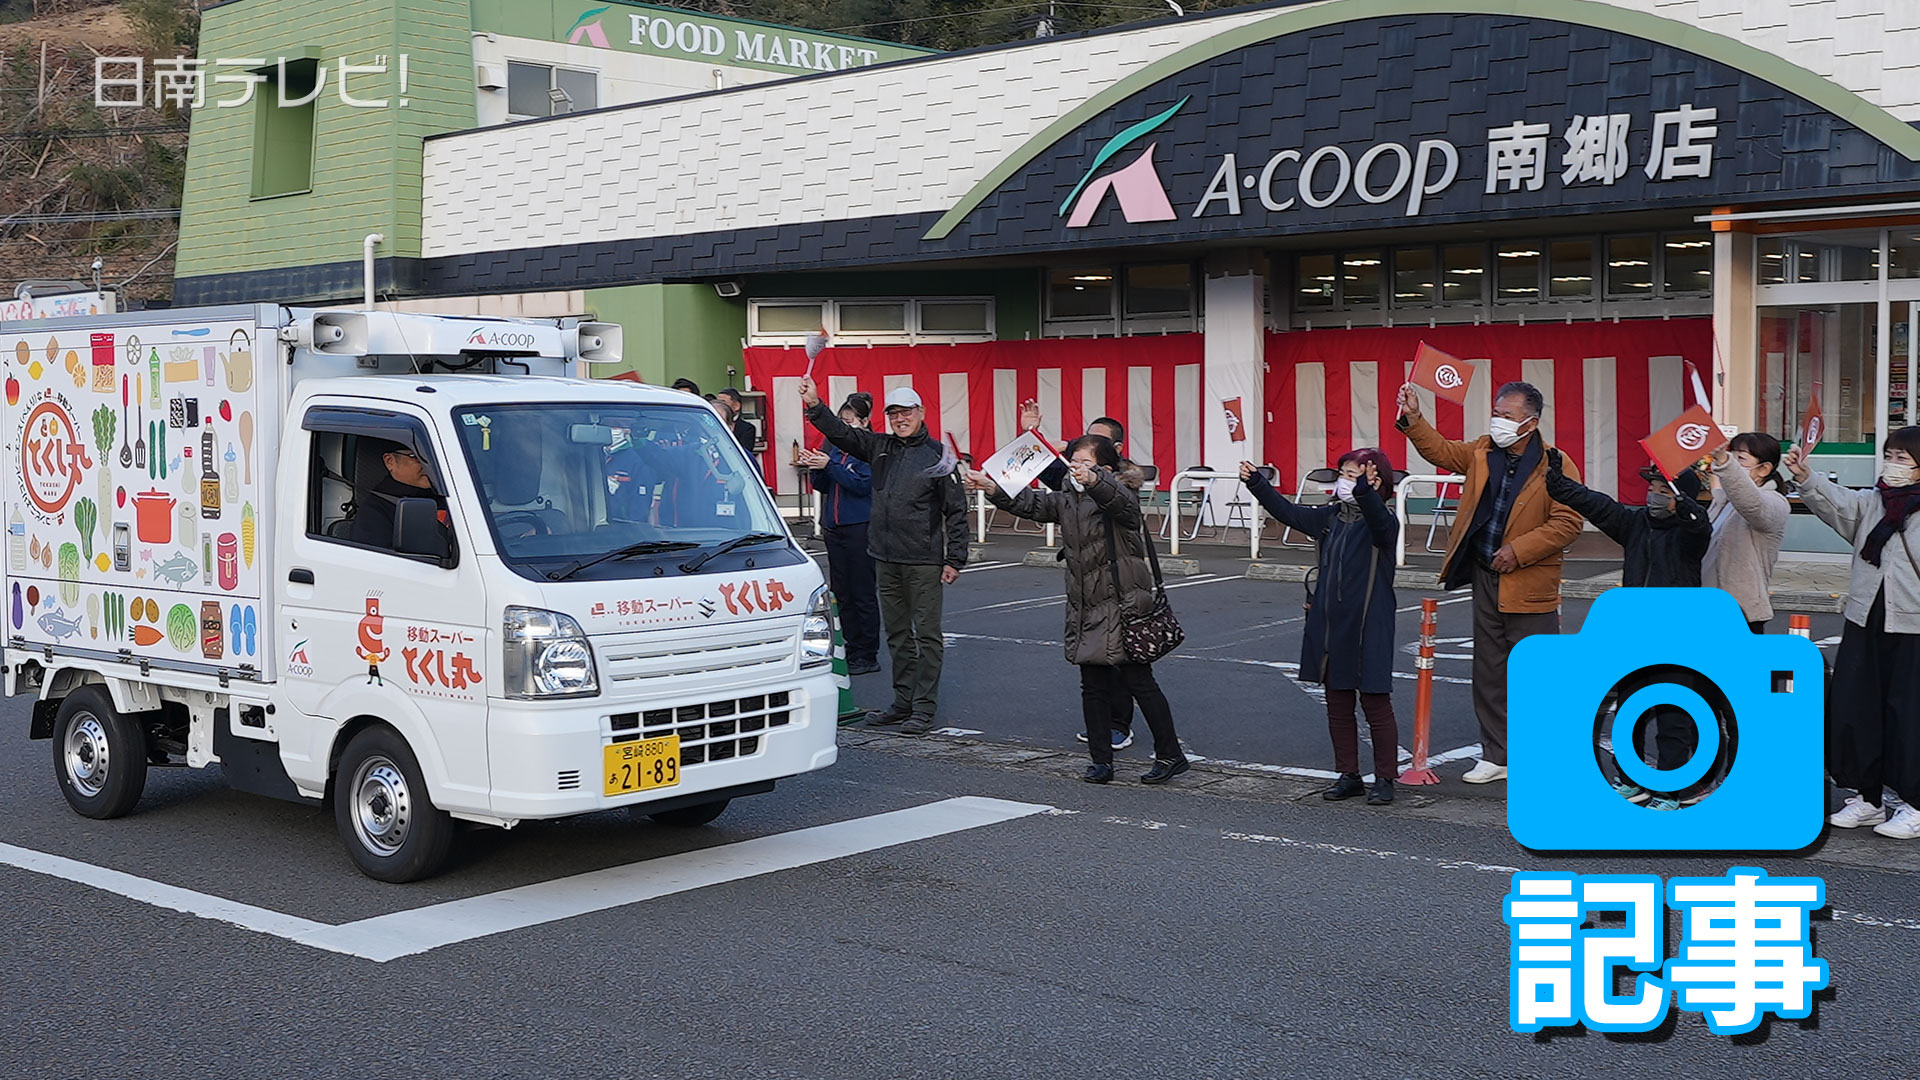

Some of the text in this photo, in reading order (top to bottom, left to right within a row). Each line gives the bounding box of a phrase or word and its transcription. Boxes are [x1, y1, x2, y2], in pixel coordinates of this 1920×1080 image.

[628, 13, 726, 57] FOOD
[1485, 104, 1719, 194] 南郷店
[28, 438, 93, 485] とくし丸
[616, 578, 795, 617] 移動スーパー とくし丸
[406, 625, 475, 645] 移動スーパー
[401, 645, 483, 691] とくし丸
[608, 756, 677, 790] あ 21-89
